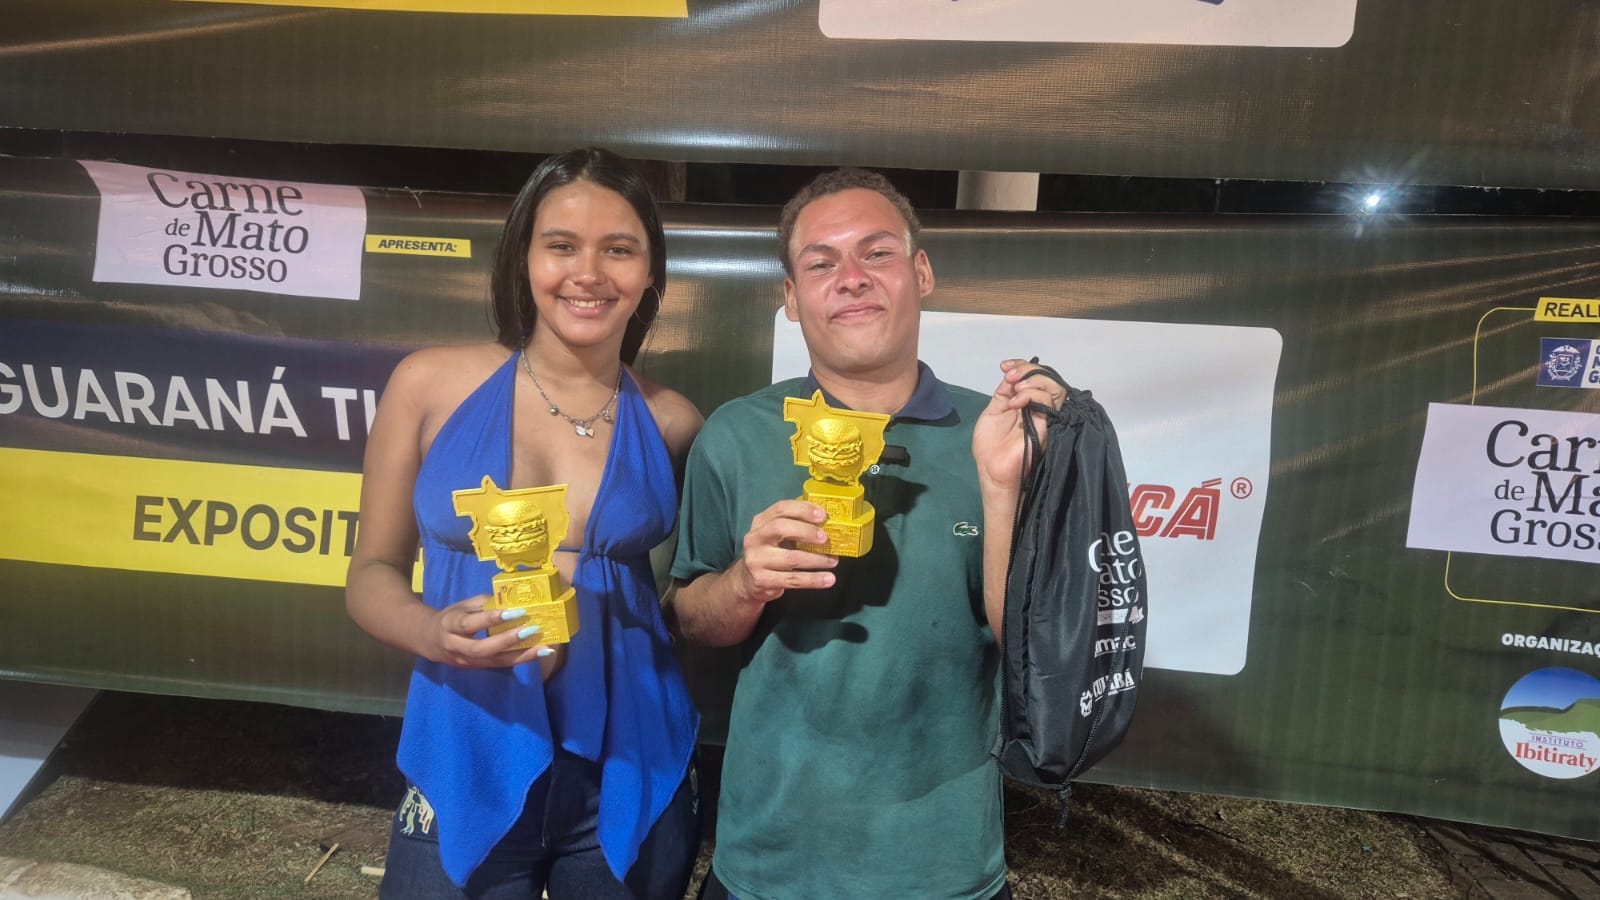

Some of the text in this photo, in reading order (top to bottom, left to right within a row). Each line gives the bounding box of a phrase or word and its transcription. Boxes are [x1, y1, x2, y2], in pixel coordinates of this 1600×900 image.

[147, 172, 303, 216] Carne
[165, 210, 309, 254] de Mato
[378, 239, 458, 253] APRESENTA:
[163, 244, 287, 283] Grosso
[1486, 420, 1600, 473] Car
[1494, 479, 1525, 501] de
[1490, 509, 1600, 550] Gros
[1515, 742, 1598, 772] Ibitiraty
[1531, 735, 1584, 748] INSTITUTO
